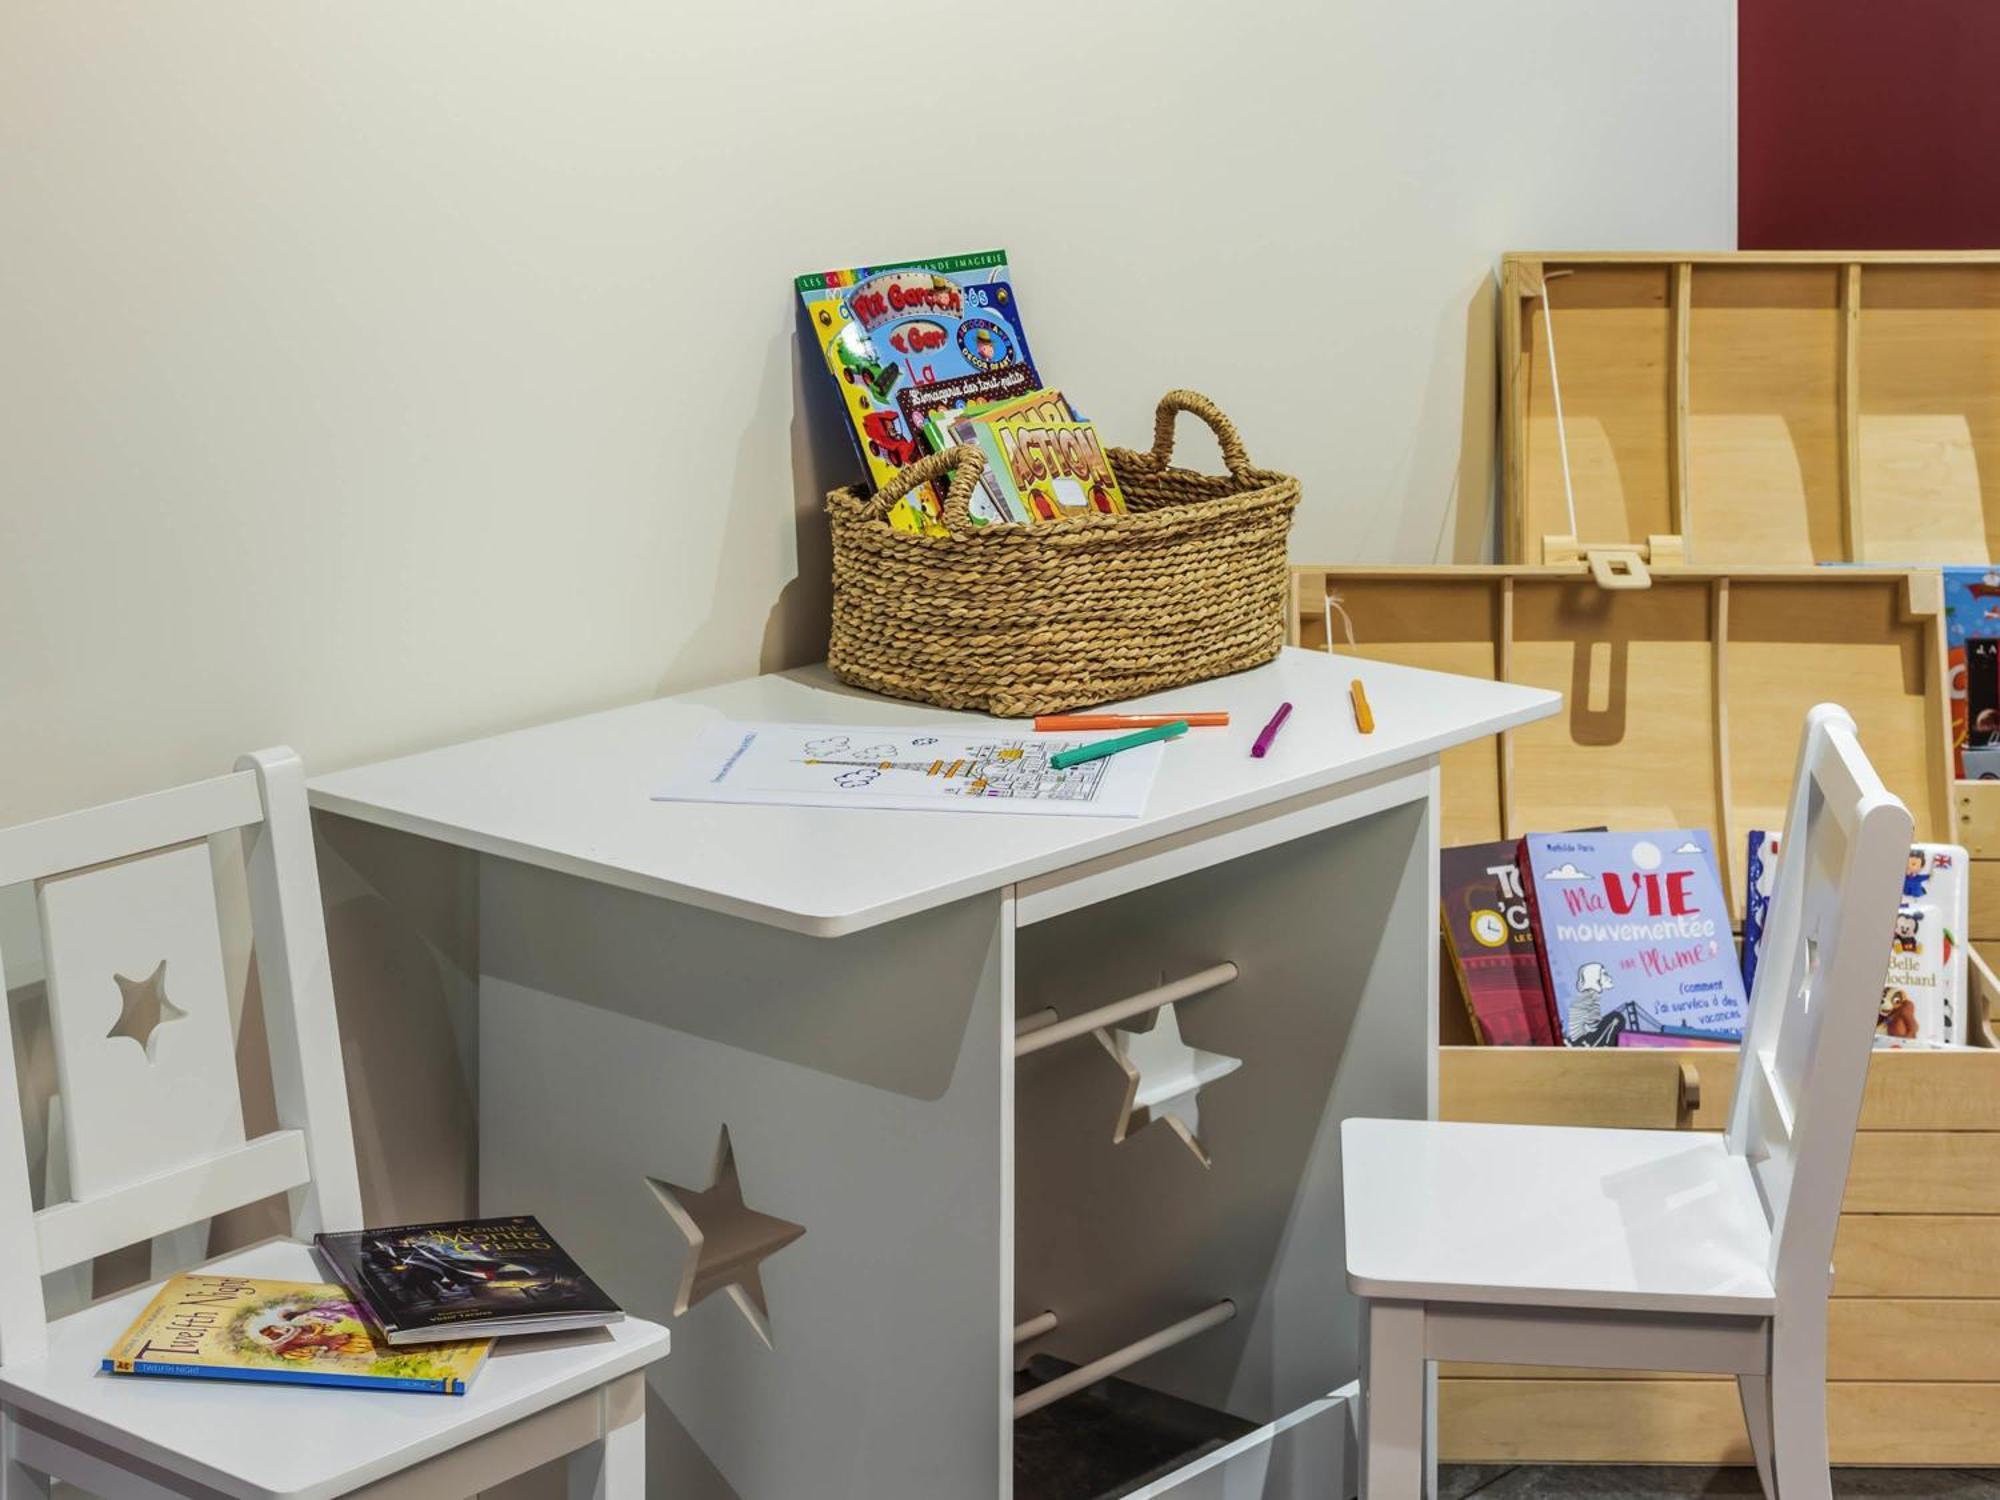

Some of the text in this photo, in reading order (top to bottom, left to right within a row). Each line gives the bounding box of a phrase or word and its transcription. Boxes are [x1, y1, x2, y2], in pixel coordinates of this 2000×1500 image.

[803, 277, 822, 288] LES
[955, 254, 1002, 268] IMAGERIE
[905, 358, 936, 386] La
[999, 426, 1115, 492] ACTION
[1563, 871, 1701, 917] Ma VIE
[1556, 912, 1716, 943] mouvementée
[1638, 944, 1706, 977] Plume
[1887, 972, 1936, 987] lochard
[430, 1231, 541, 1244] Monte
[454, 1241, 551, 1253] Cristo
[135, 1311, 220, 1359] Twelfth
